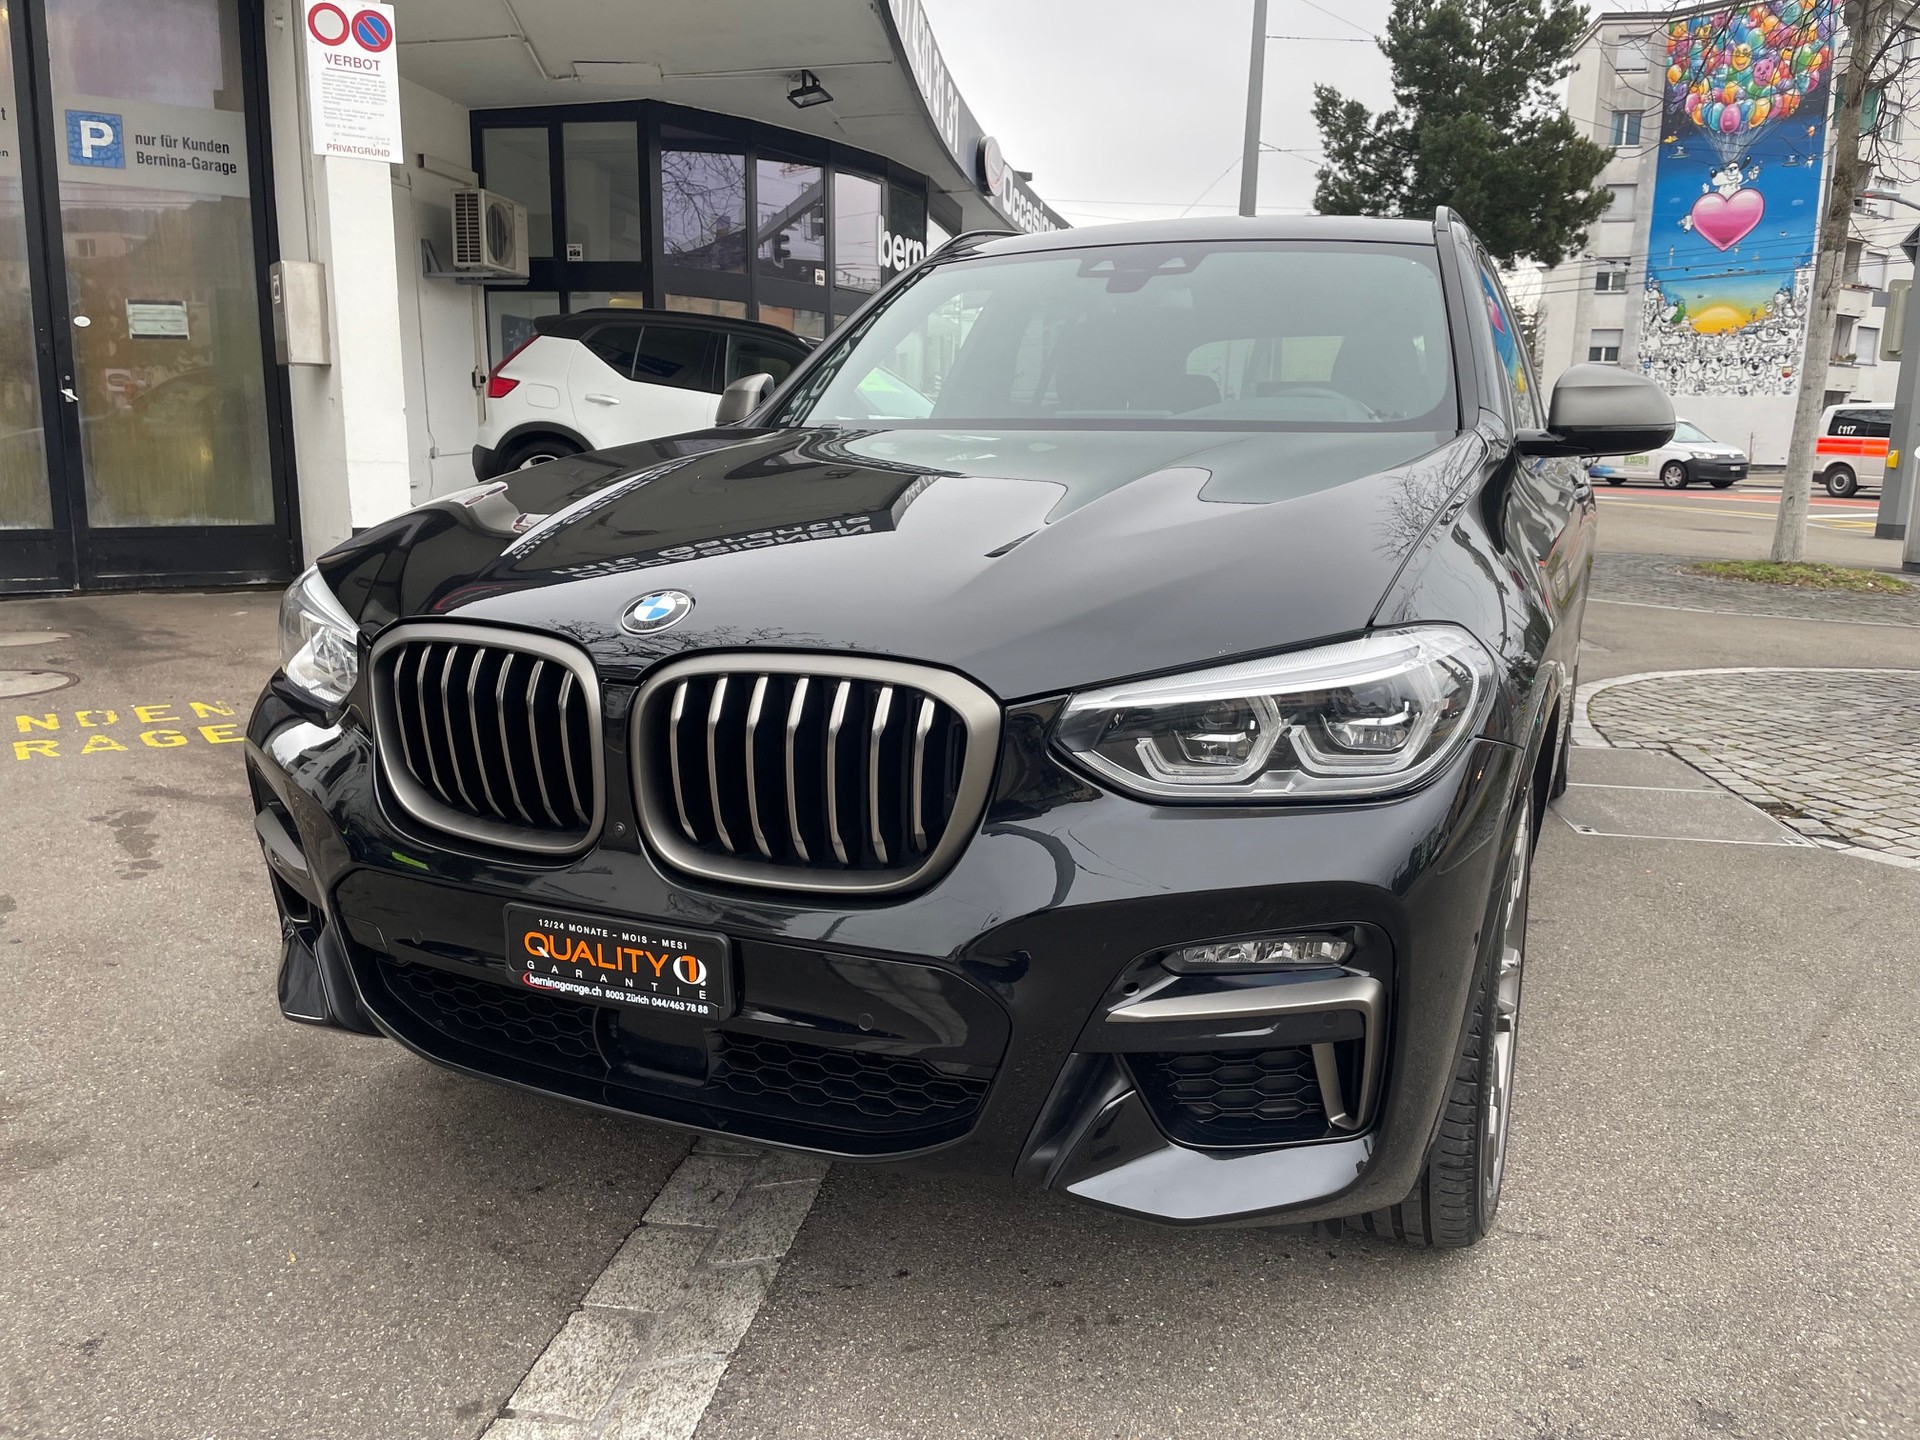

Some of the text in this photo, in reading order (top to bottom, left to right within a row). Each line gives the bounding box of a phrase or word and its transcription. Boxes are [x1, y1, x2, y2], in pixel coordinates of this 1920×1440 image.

[324, 52, 381, 71] VERBOT
[933, 49, 945, 129] 31
[946, 81, 960, 154] 31
[80, 120, 114, 158] P
[135, 134, 230, 154] nur für Kunden
[326, 143, 391, 158] PRIVATGRUND
[136, 151, 237, 175] Bernina-Garage
[878, 214, 928, 271] bern
[1842, 425, 1857, 435] 117
[538, 918, 565, 930] 12/24
[568, 924, 608, 938] MONATE
[621, 932, 648, 944] MOIS
[661, 939, 687, 950] MESI
[526, 960, 707, 999] GARANTIE
[529, 974, 709, 1015] berninagarage.ch 8003 Zürich 044/463 78 88
